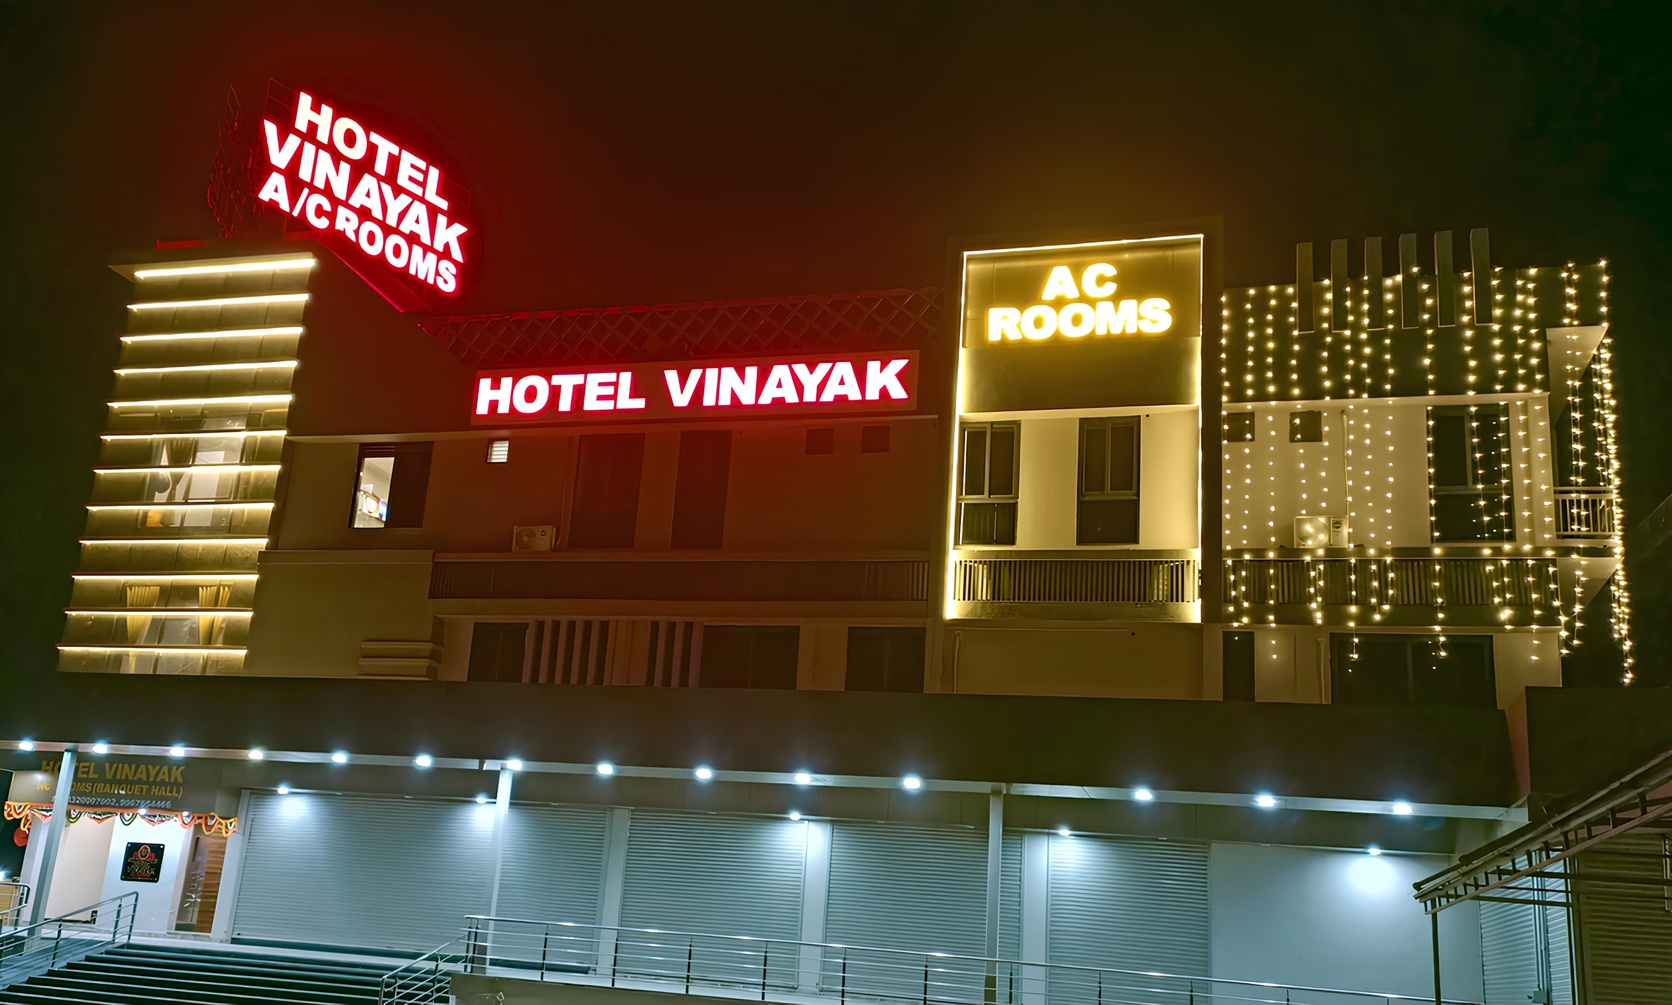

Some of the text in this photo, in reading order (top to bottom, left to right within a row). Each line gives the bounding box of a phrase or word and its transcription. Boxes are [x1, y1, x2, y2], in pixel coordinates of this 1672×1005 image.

[294, 91, 449, 212] HOTEL
[263, 118, 469, 264] VINAYAK
[257, 171, 458, 294] A/C ROOMS
[988, 298, 1173, 341] ROOMS
[475, 358, 910, 415] HOTEL VINAYAK
[41, 760, 186, 783] HEL VINAYAK
[150, 785, 183, 799] HALL)
